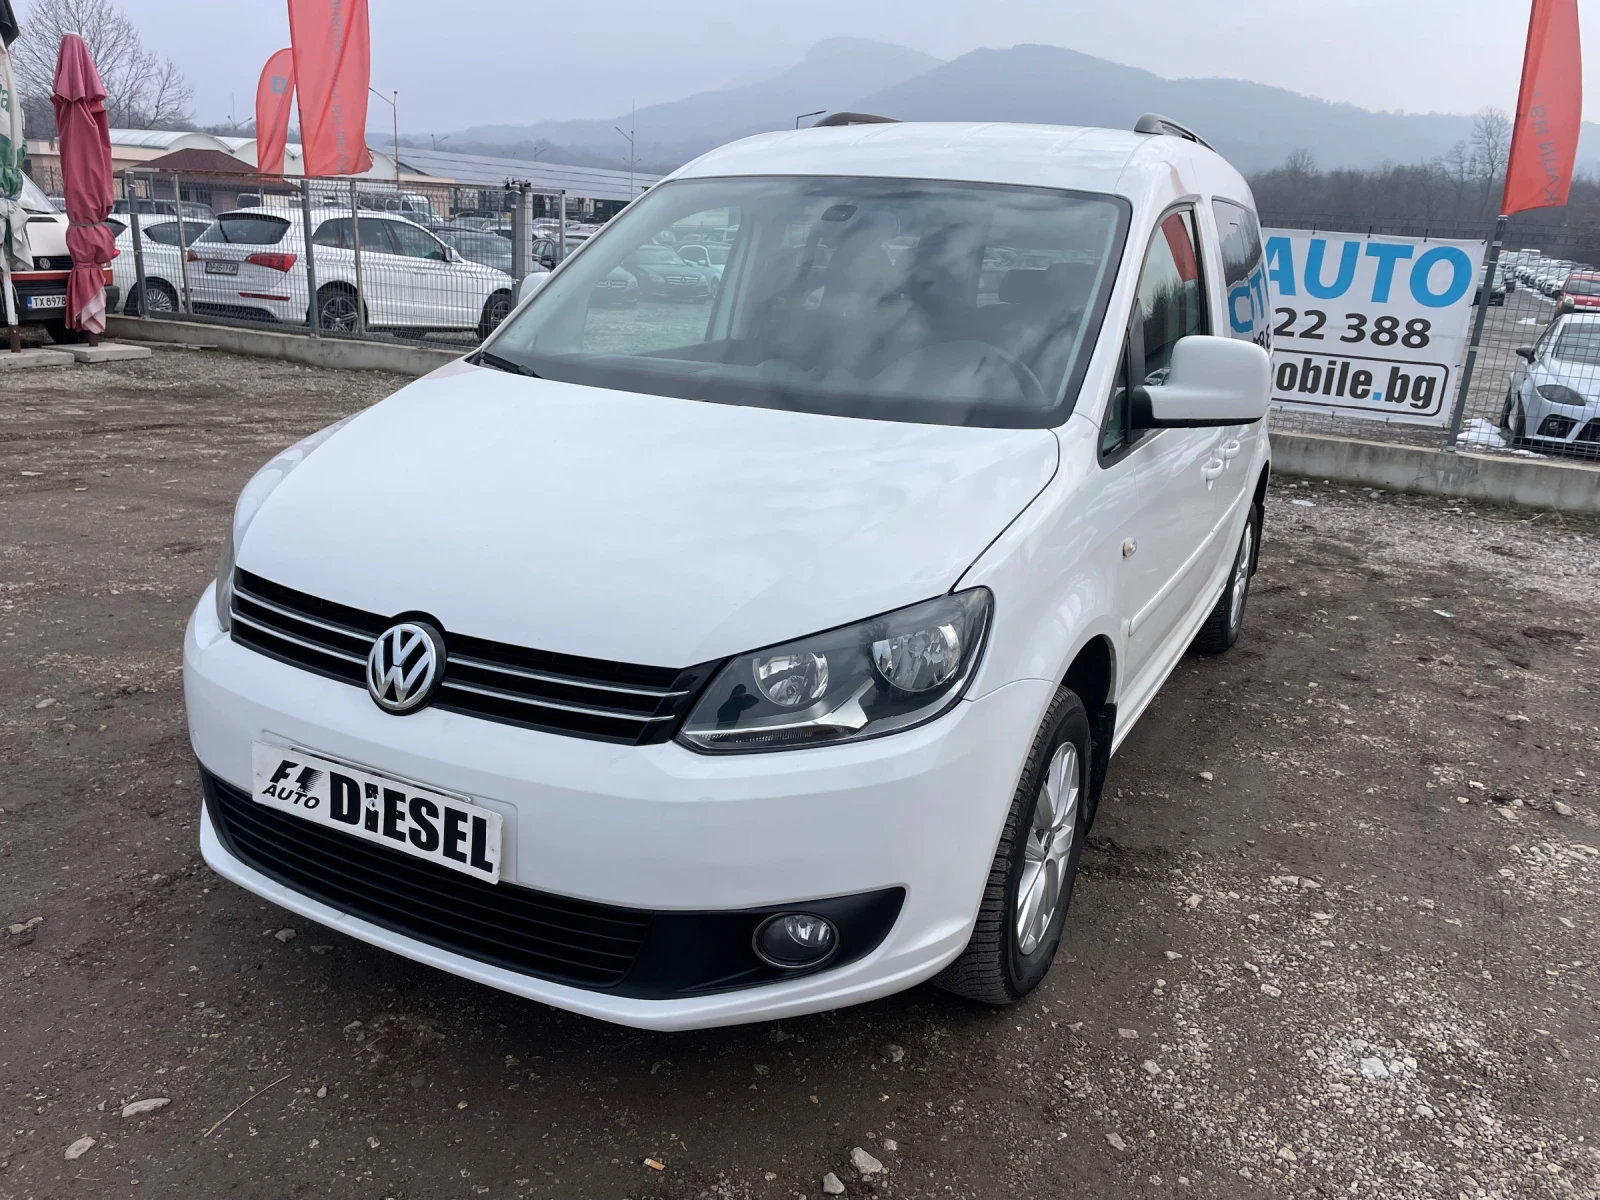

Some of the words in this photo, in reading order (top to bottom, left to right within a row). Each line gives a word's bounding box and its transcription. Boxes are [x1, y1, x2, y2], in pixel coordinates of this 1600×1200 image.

[1264, 236, 1473, 308] AUTO
[1273, 307, 1327, 340] 22
[1340, 313, 1431, 349] 388
[1272, 358, 1437, 409] obile.bg
[262, 784, 320, 809] AUTO
